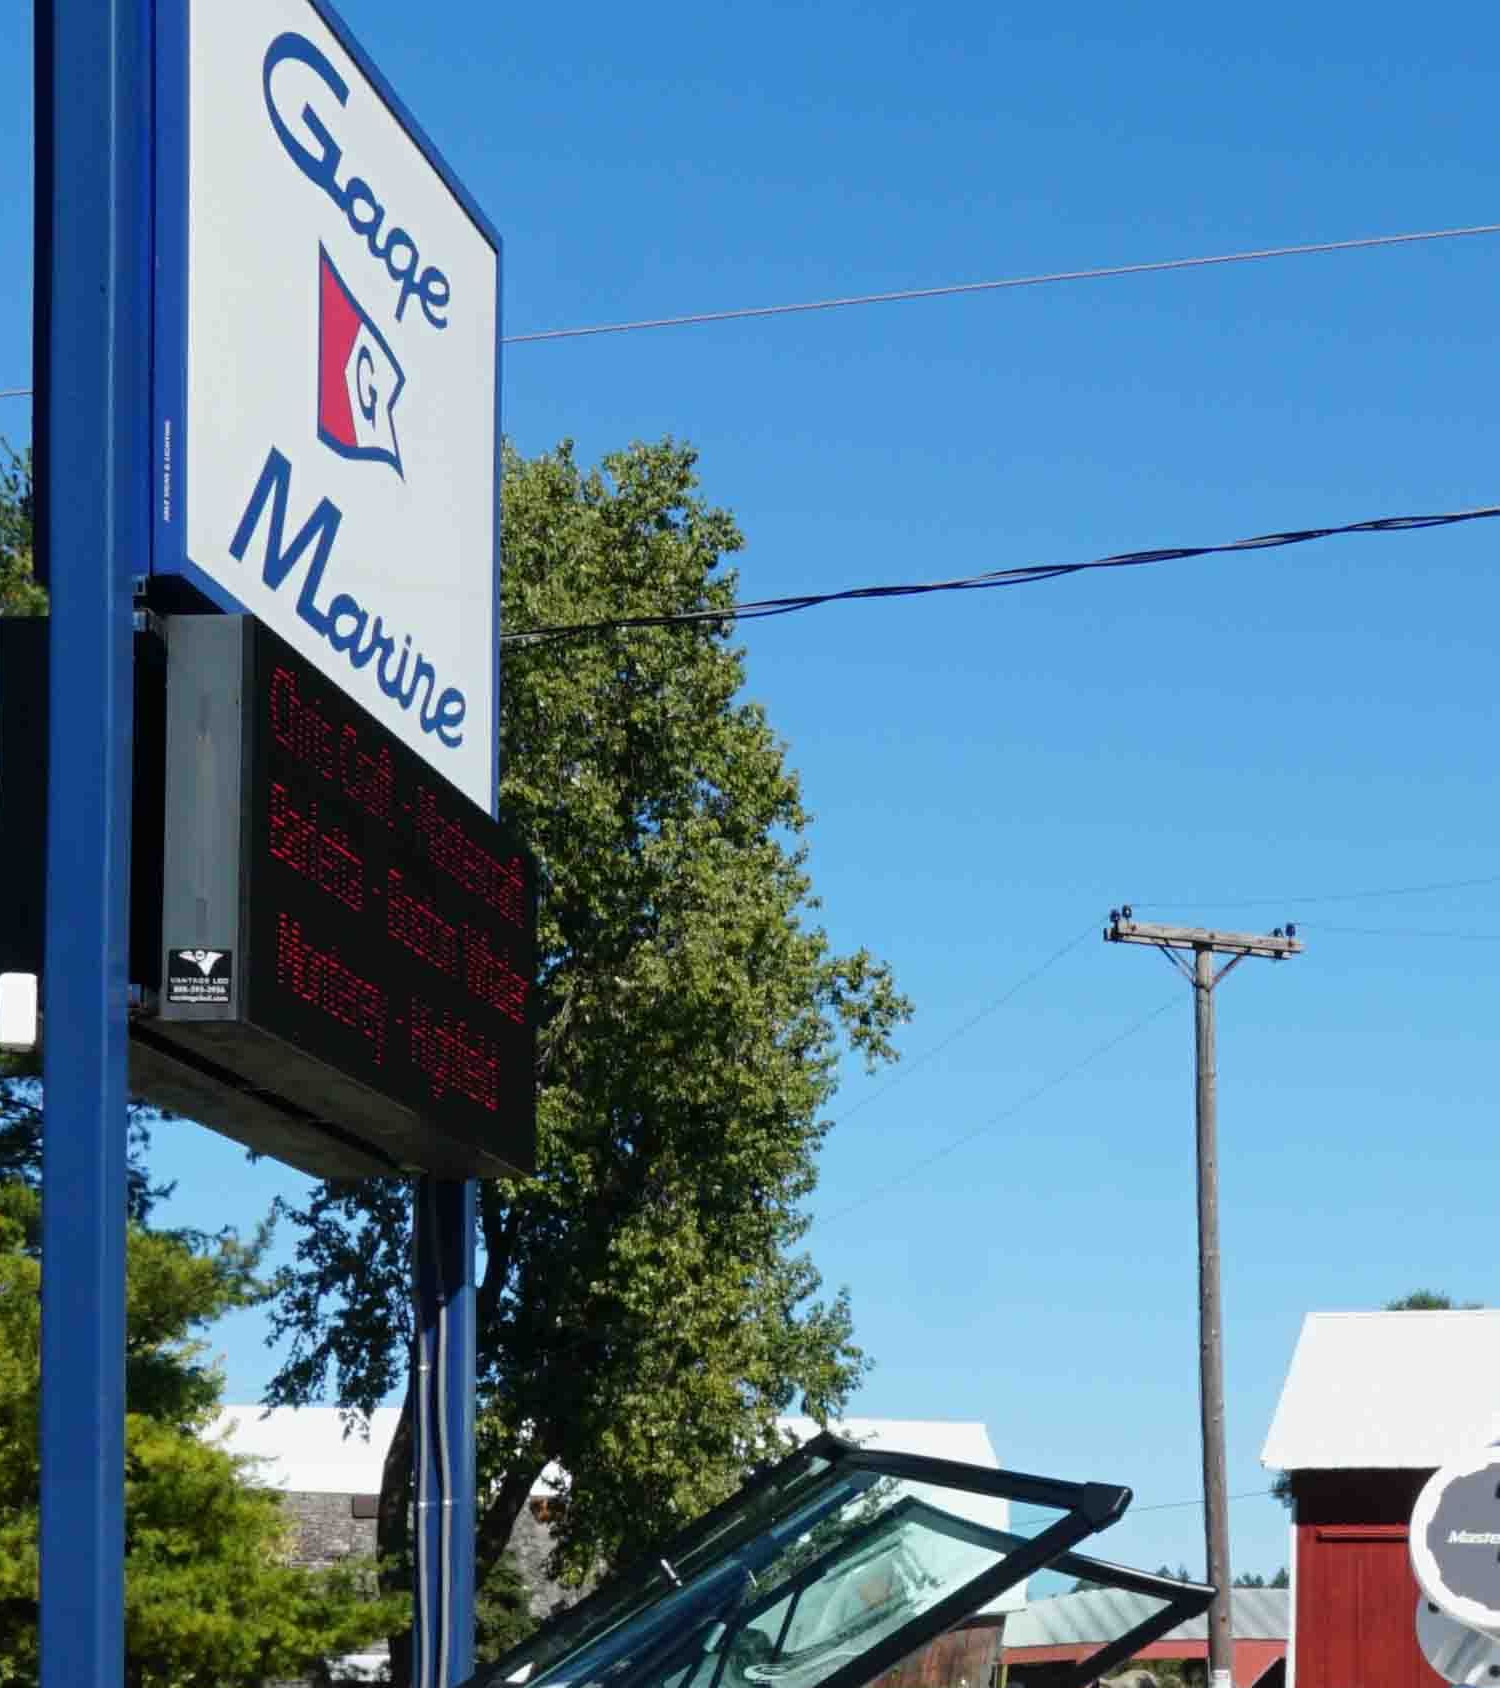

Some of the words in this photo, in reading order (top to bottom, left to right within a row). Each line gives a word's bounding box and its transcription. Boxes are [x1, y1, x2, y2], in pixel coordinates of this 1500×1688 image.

[263, 31, 451, 329] Gage
[356, 346, 378, 429] G
[229, 446, 466, 748] Marine
